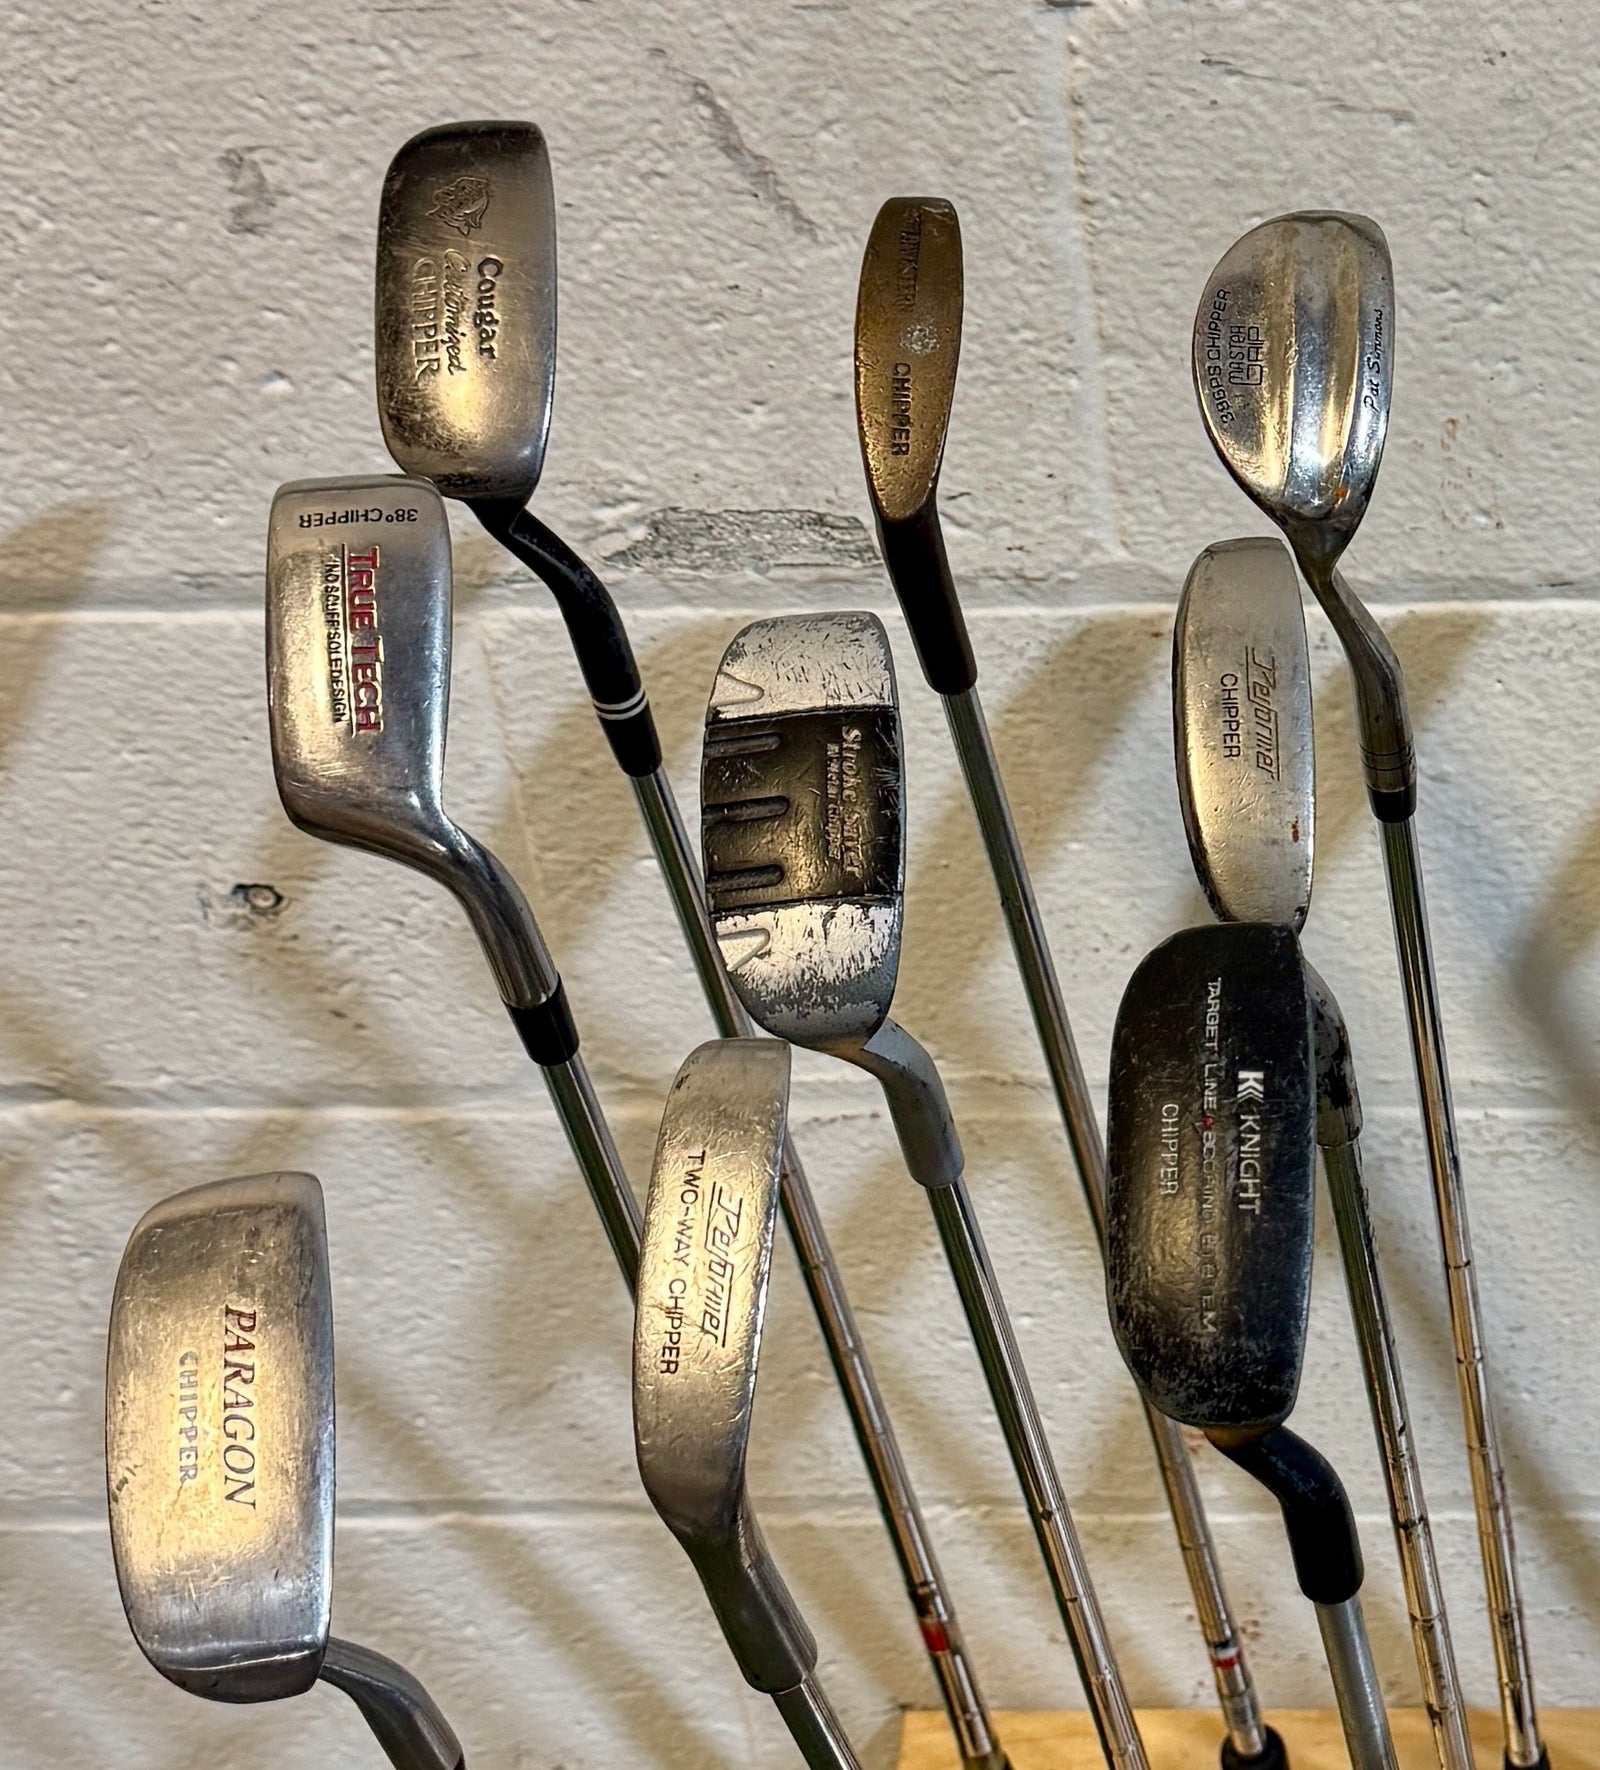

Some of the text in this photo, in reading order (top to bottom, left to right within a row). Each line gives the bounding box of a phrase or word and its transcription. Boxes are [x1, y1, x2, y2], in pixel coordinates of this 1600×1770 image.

[412, 257, 441, 384] CHIPPER
[440, 248, 472, 376] Customized
[477, 255, 503, 361] Cougar
[1206, 288, 1236, 425] 396PS CHIPPER
[1246, 325, 1265, 386] GRIP
[892, 362, 912, 456] CHIPPER
[1363, 379, 1380, 413] Pat
[327, 632, 344, 668] SOLE
[348, 546, 385, 734] TRUE TECH
[330, 669, 347, 723] DESIGN
[1220, 673, 1241, 758] CHIPPER
[1205, 976, 1222, 1051] TARGET
[1202, 1062, 1219, 1111] LINE
[1160, 1102, 1180, 1197] CHIPPER
[1237, 1113, 1262, 1217] KNIGHT
[659, 1149, 706, 1376] TWO-WAY CHIPPER
[173, 1350, 200, 1485] CHIPPER
[223, 1304, 258, 1511] PARAGON
